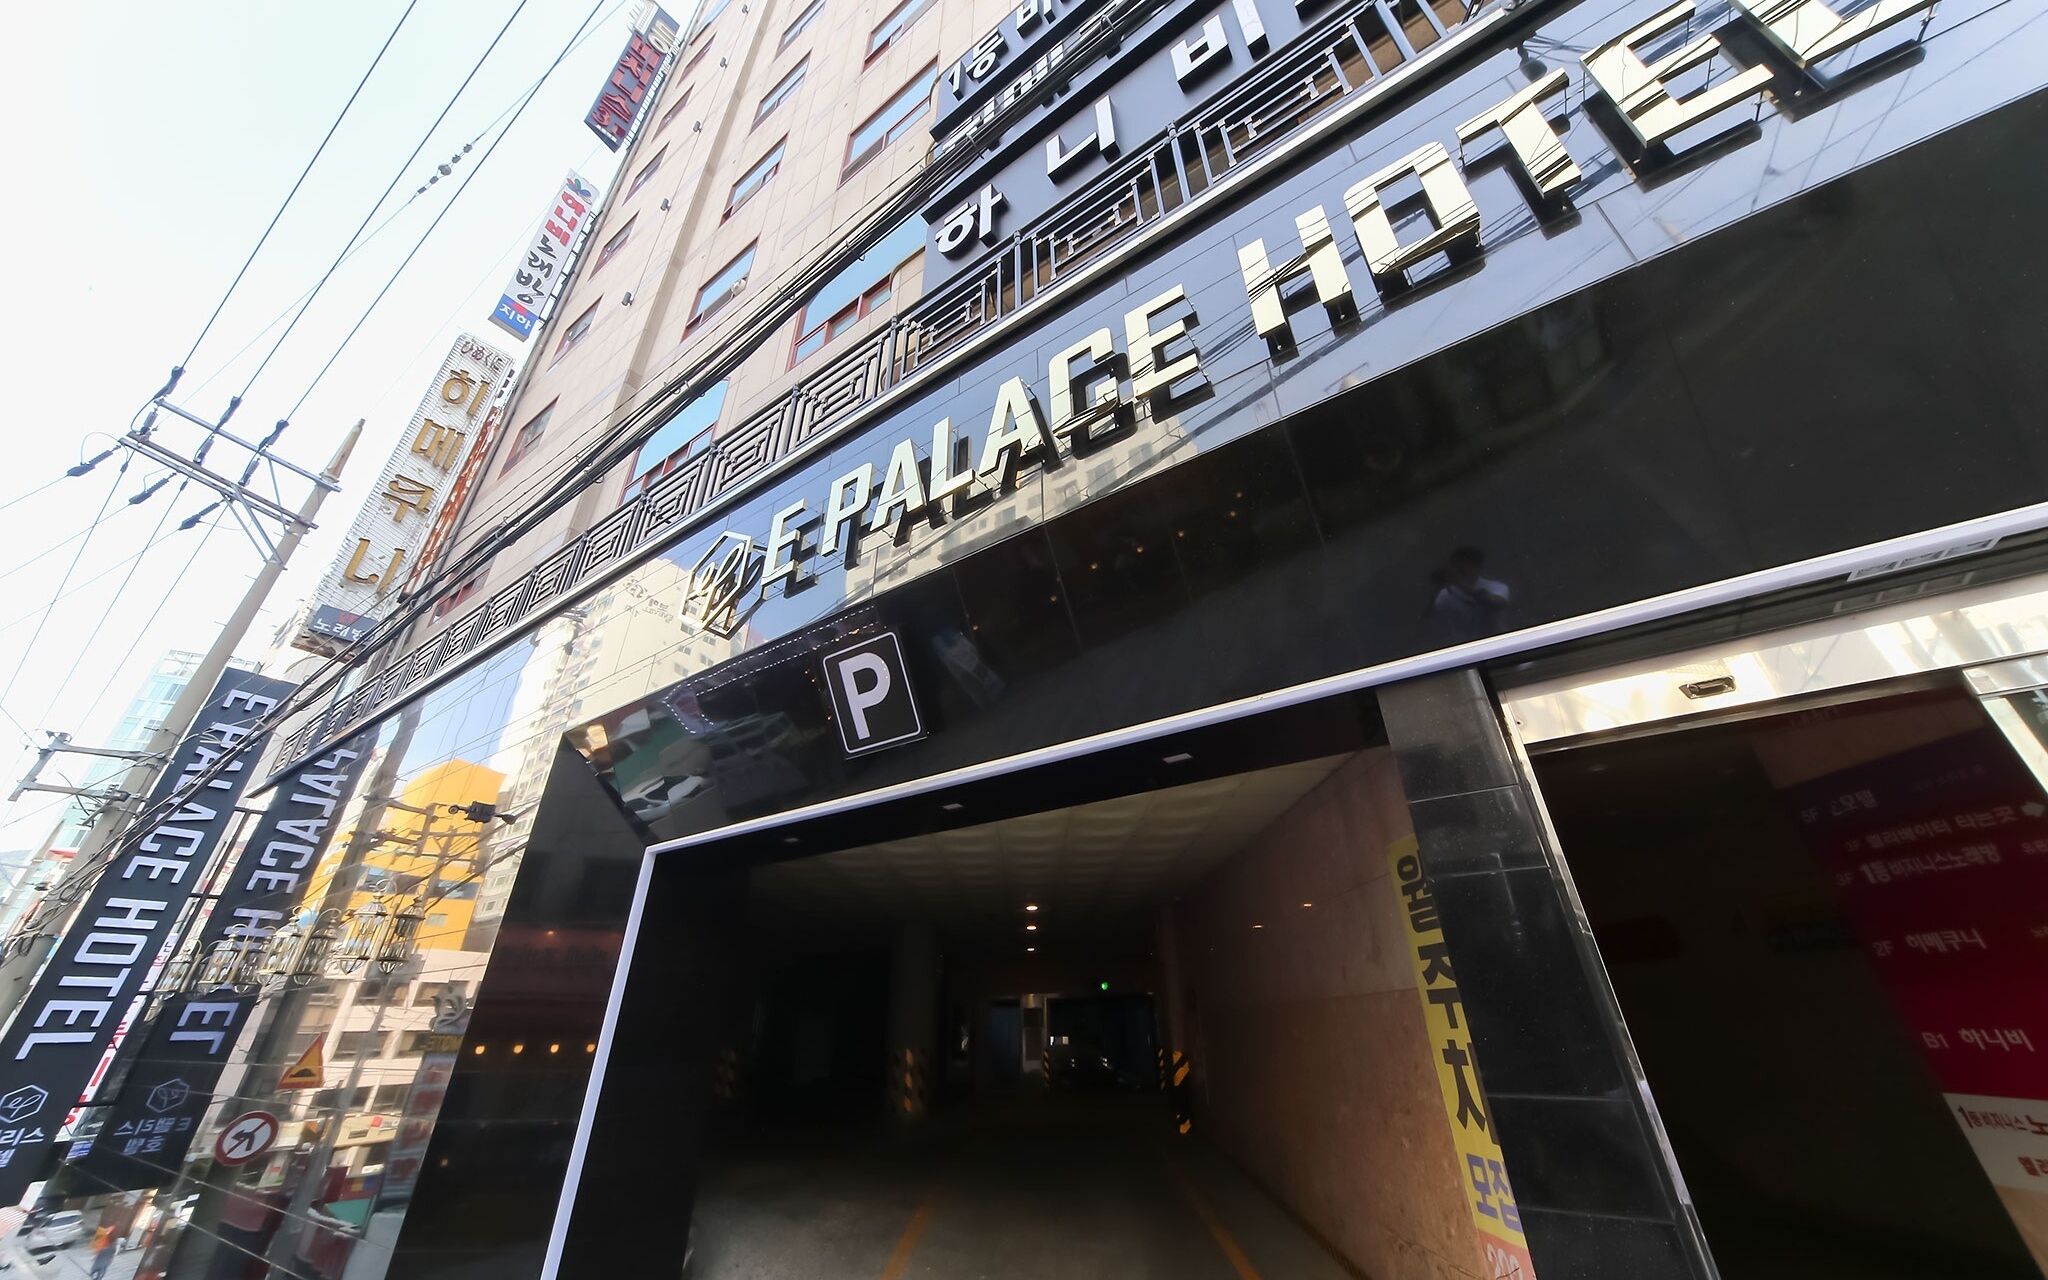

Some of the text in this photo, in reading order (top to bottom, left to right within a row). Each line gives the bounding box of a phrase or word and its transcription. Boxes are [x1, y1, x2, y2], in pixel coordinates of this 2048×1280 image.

[515, 233, 557, 305] 노래방
[761, 0, 1937, 587] E PALACE HOTEL
[500, 305, 532, 330] 지하
[344, 368, 491, 596] 히메쿠니
[221, 689, 278, 716] E
[837, 650, 892, 739] P
[15, 897, 169, 1061] HOTEL
[1921, 1027, 2035, 1053] B1 하니비
